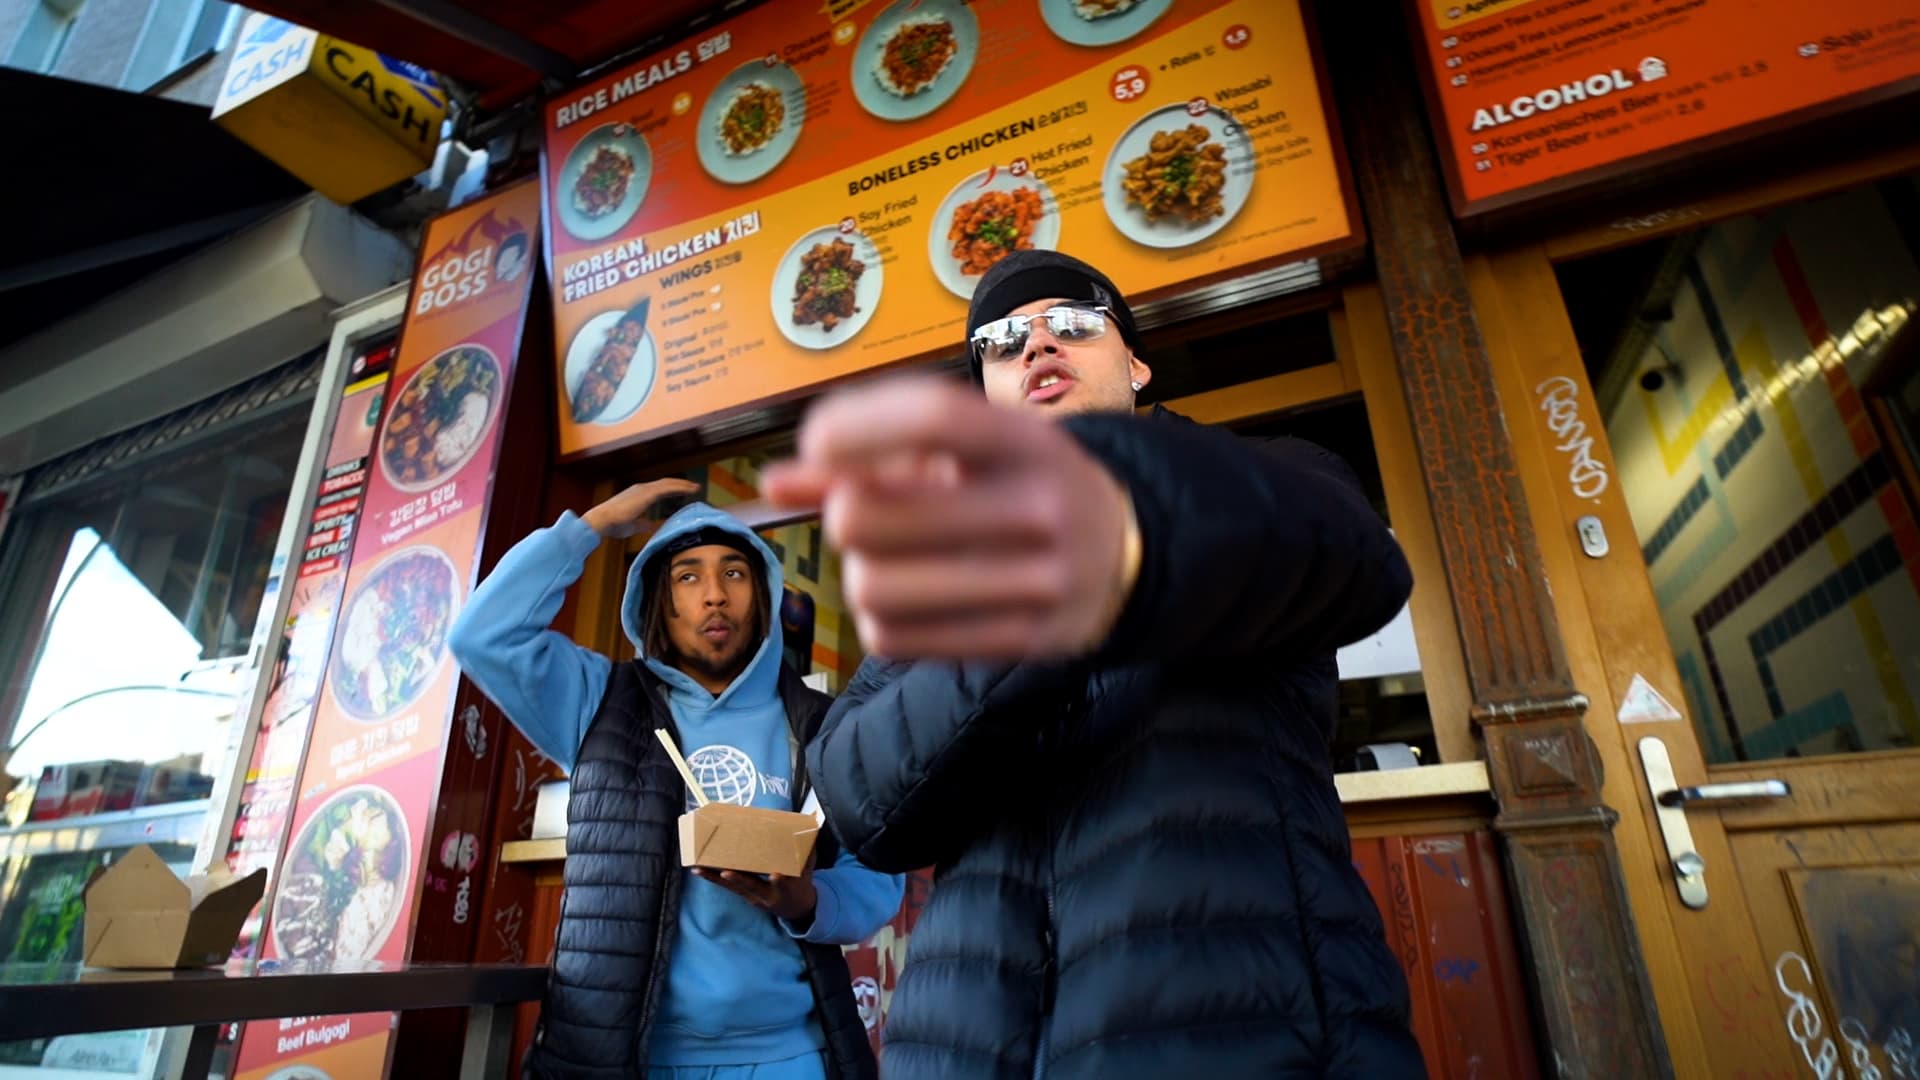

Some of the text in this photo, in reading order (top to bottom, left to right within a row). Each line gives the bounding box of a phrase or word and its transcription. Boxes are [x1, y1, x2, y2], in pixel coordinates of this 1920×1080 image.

[227, 34, 308, 97] CASH
[325, 46, 431, 144] CASH
[556, 88, 608, 128] RICE
[612, 50, 692, 103] MEALS
[1114, 79, 1146, 99] 5,9
[1214, 75, 1273, 102] Wasabi
[1472, 69, 1633, 130] ALCOHOL
[848, 117, 1037, 196] BONELESS CHICKEN
[1031, 147, 1056, 164] Hot
[1057, 134, 1094, 160] Fried
[1034, 155, 1089, 179] Chicken
[858, 210, 881, 223] Soy
[884, 193, 918, 214] Fried
[862, 215, 913, 237] Chicken
[422, 245, 493, 289] GOGI
[563, 238, 646, 283] KOREAN
[563, 269, 621, 304] FRIED
[624, 231, 723, 279] CHICKEN
[659, 259, 713, 289] WINGS
[415, 269, 488, 315] BOSS
[277, 1030, 305, 1054] Beef
[305, 1018, 352, 1046] Bulgogi
